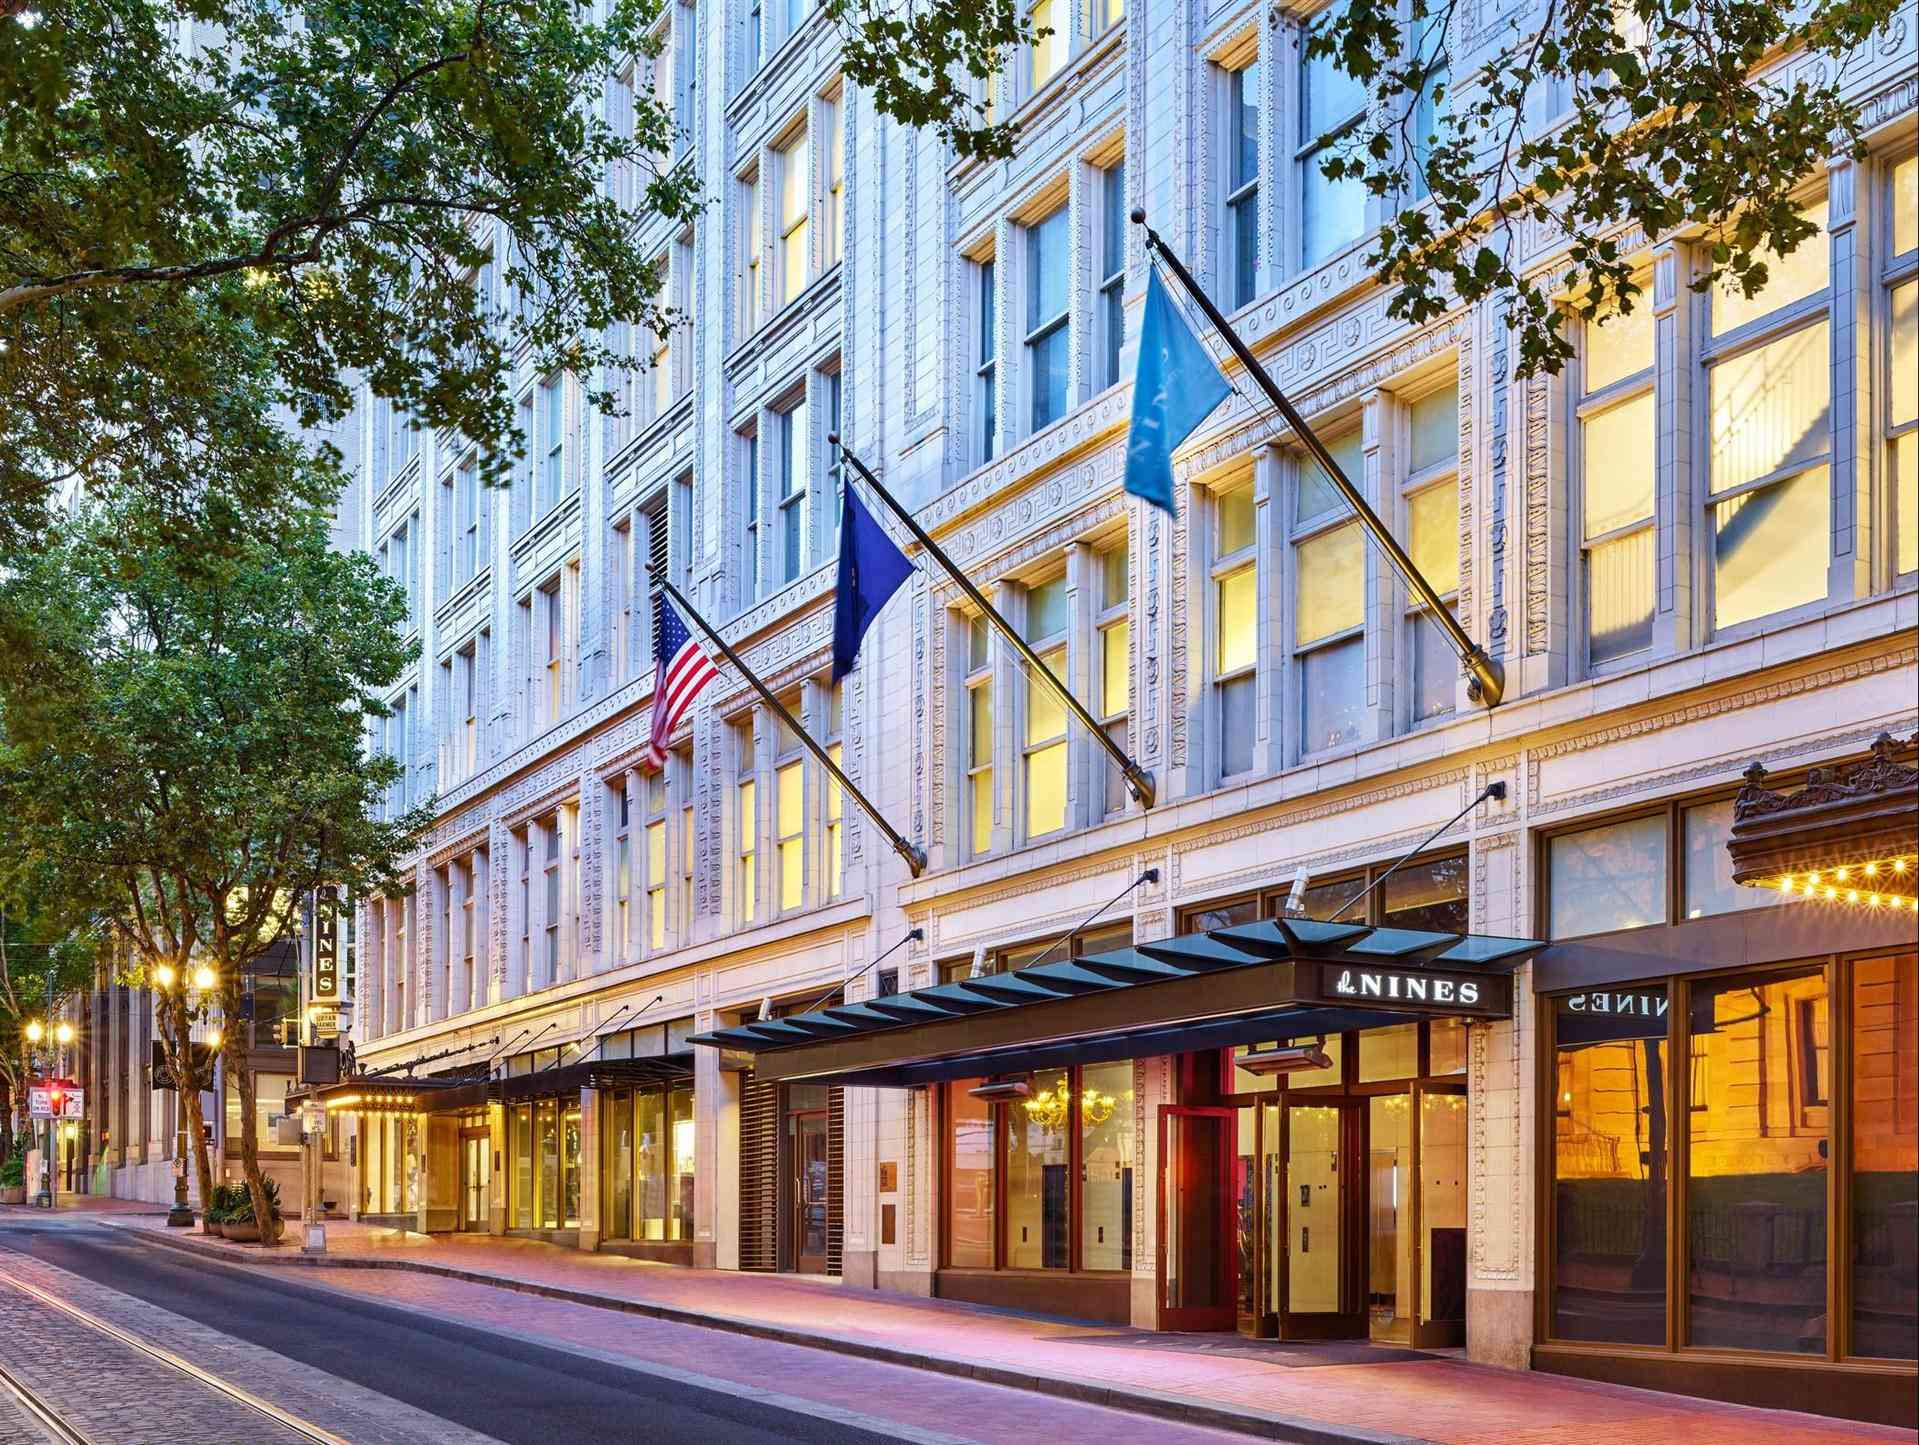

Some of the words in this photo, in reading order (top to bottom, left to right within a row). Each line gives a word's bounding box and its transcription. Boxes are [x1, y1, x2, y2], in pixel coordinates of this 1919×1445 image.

[319, 903, 333, 992] NINES
[1337, 970, 1356, 994] the
[1360, 973, 1479, 1004] NINES
